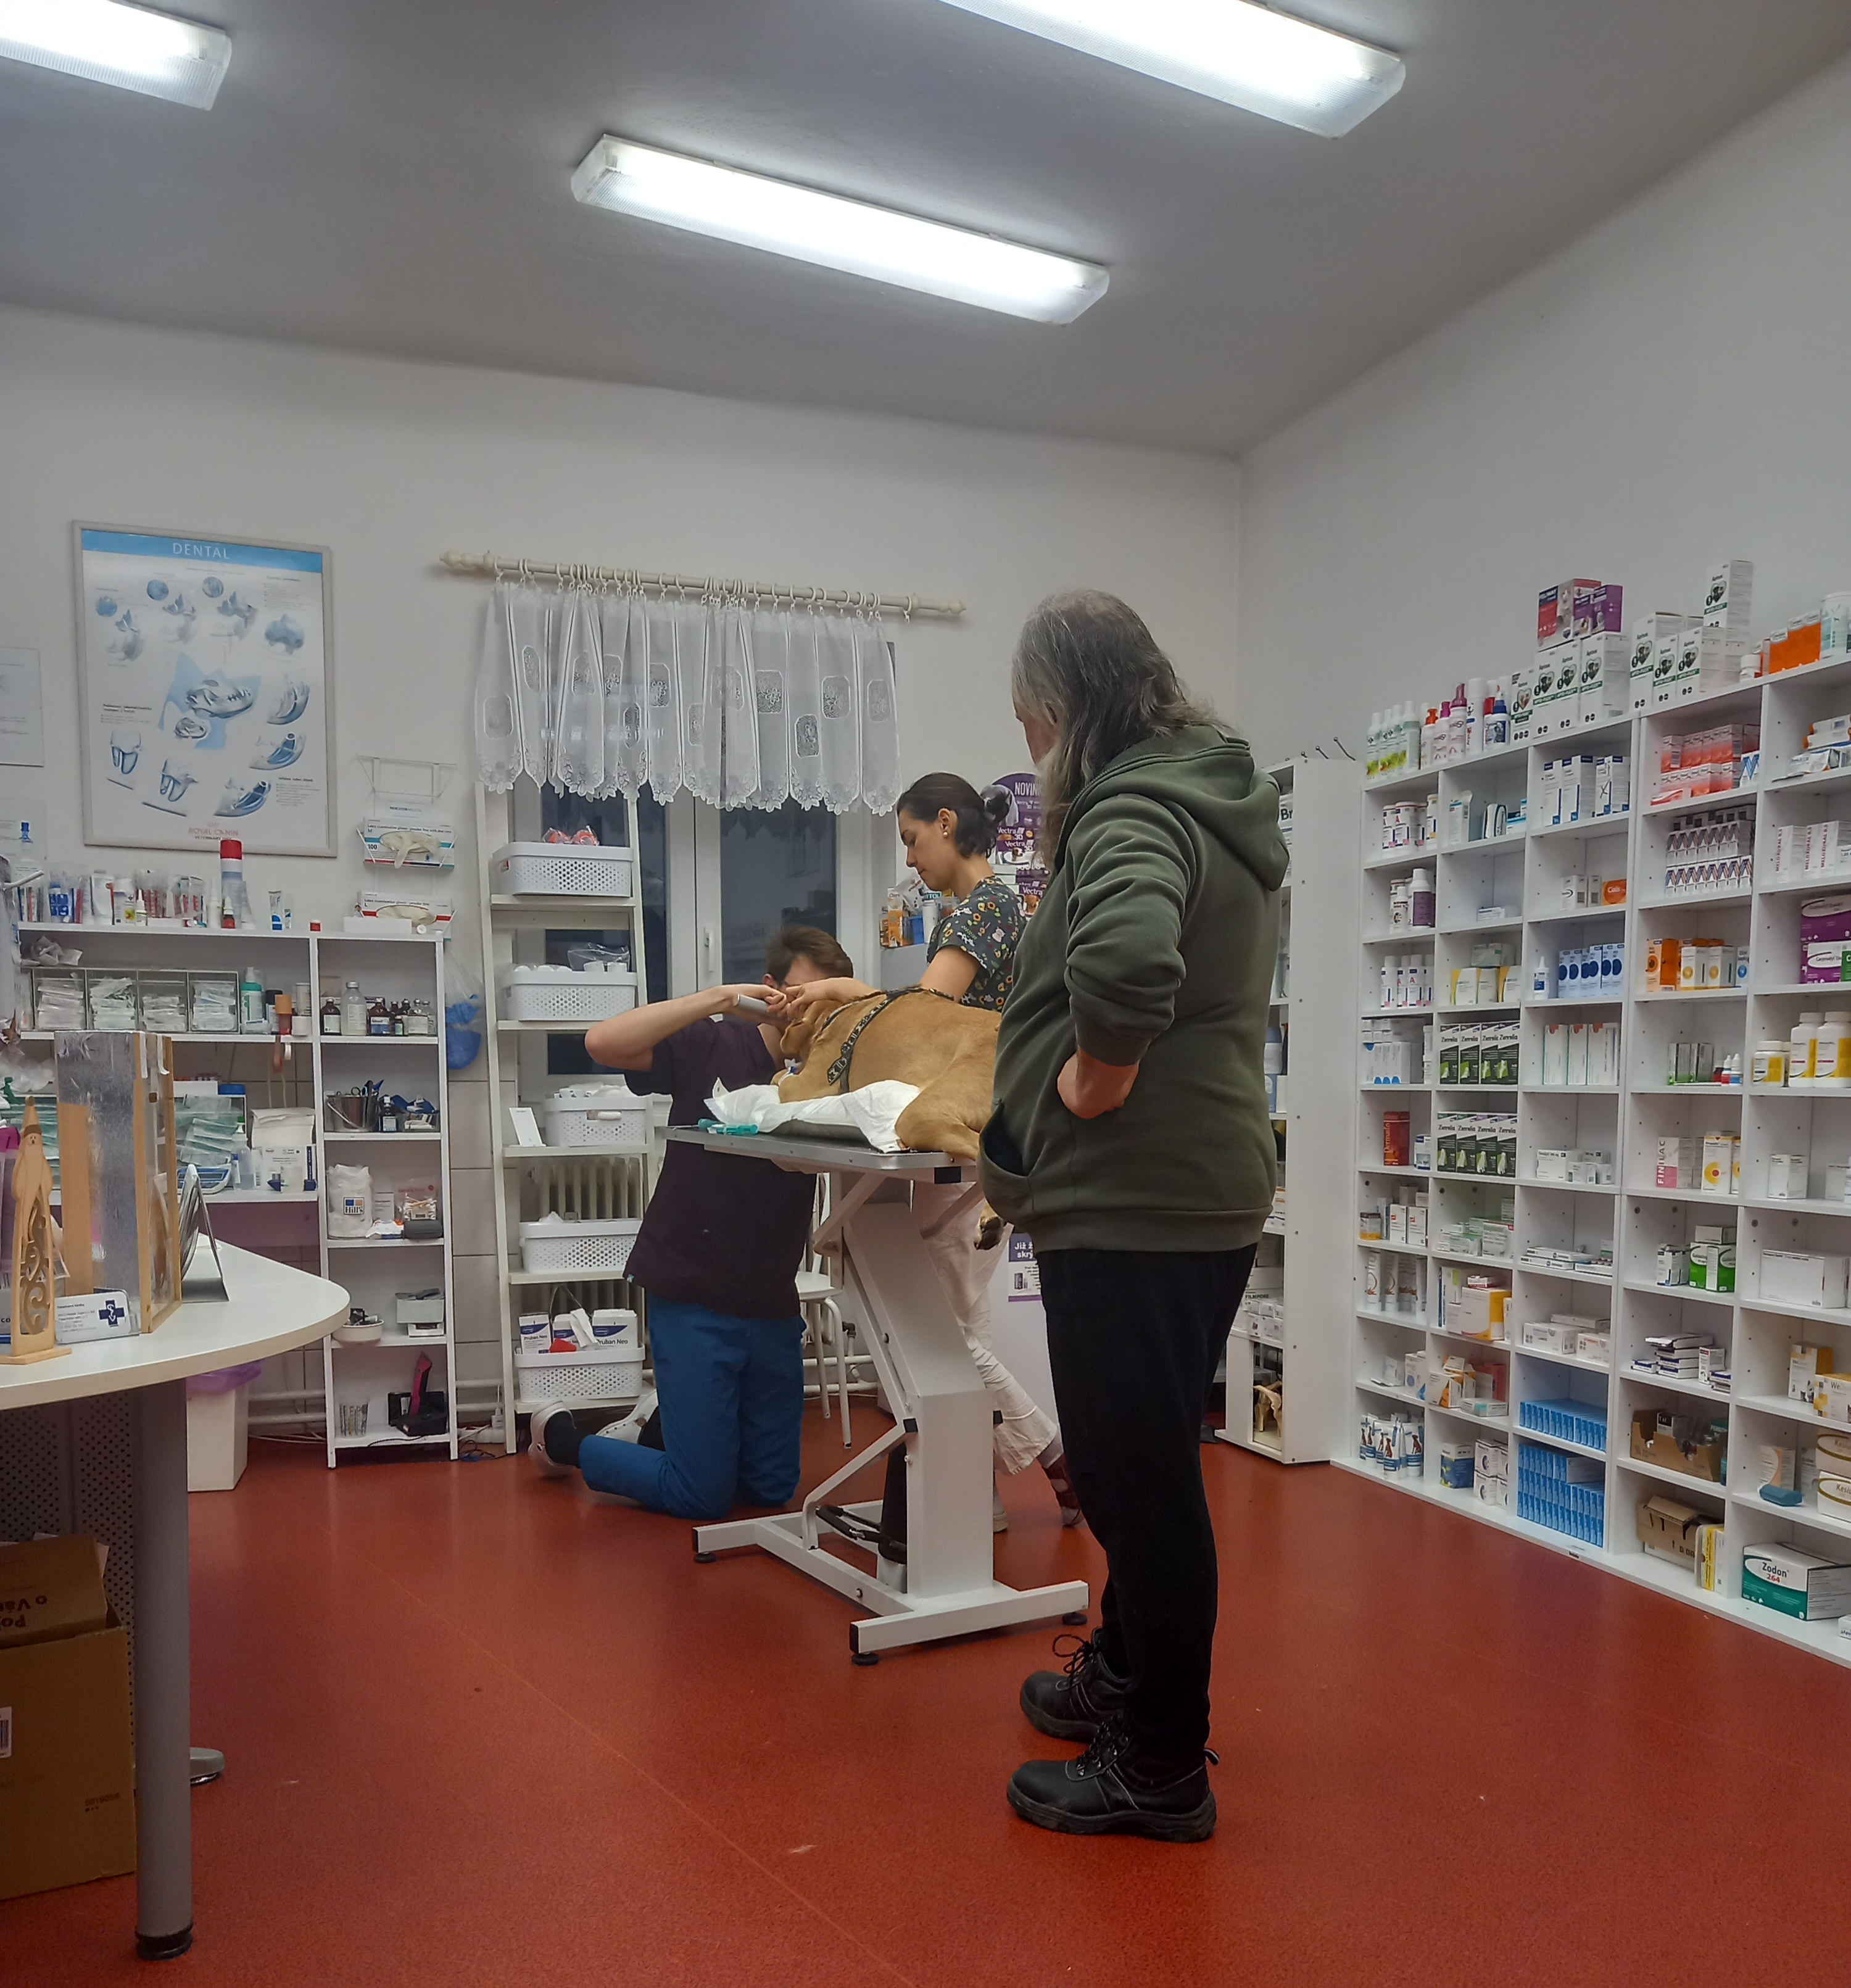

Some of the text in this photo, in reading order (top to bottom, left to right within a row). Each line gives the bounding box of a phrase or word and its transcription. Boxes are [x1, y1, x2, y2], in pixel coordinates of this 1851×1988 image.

[173, 542, 230, 560] DENTAL
[1022, 887, 1043, 897] Vectra
[1657, 1140, 1666, 1184] FINILAC
[345, 1206, 363, 1214] Hill's
[1014, 1242, 1027, 1250] Již
[1762, 1561, 1787, 1578] Zodon
[1766, 1573, 1781, 1583] 264
